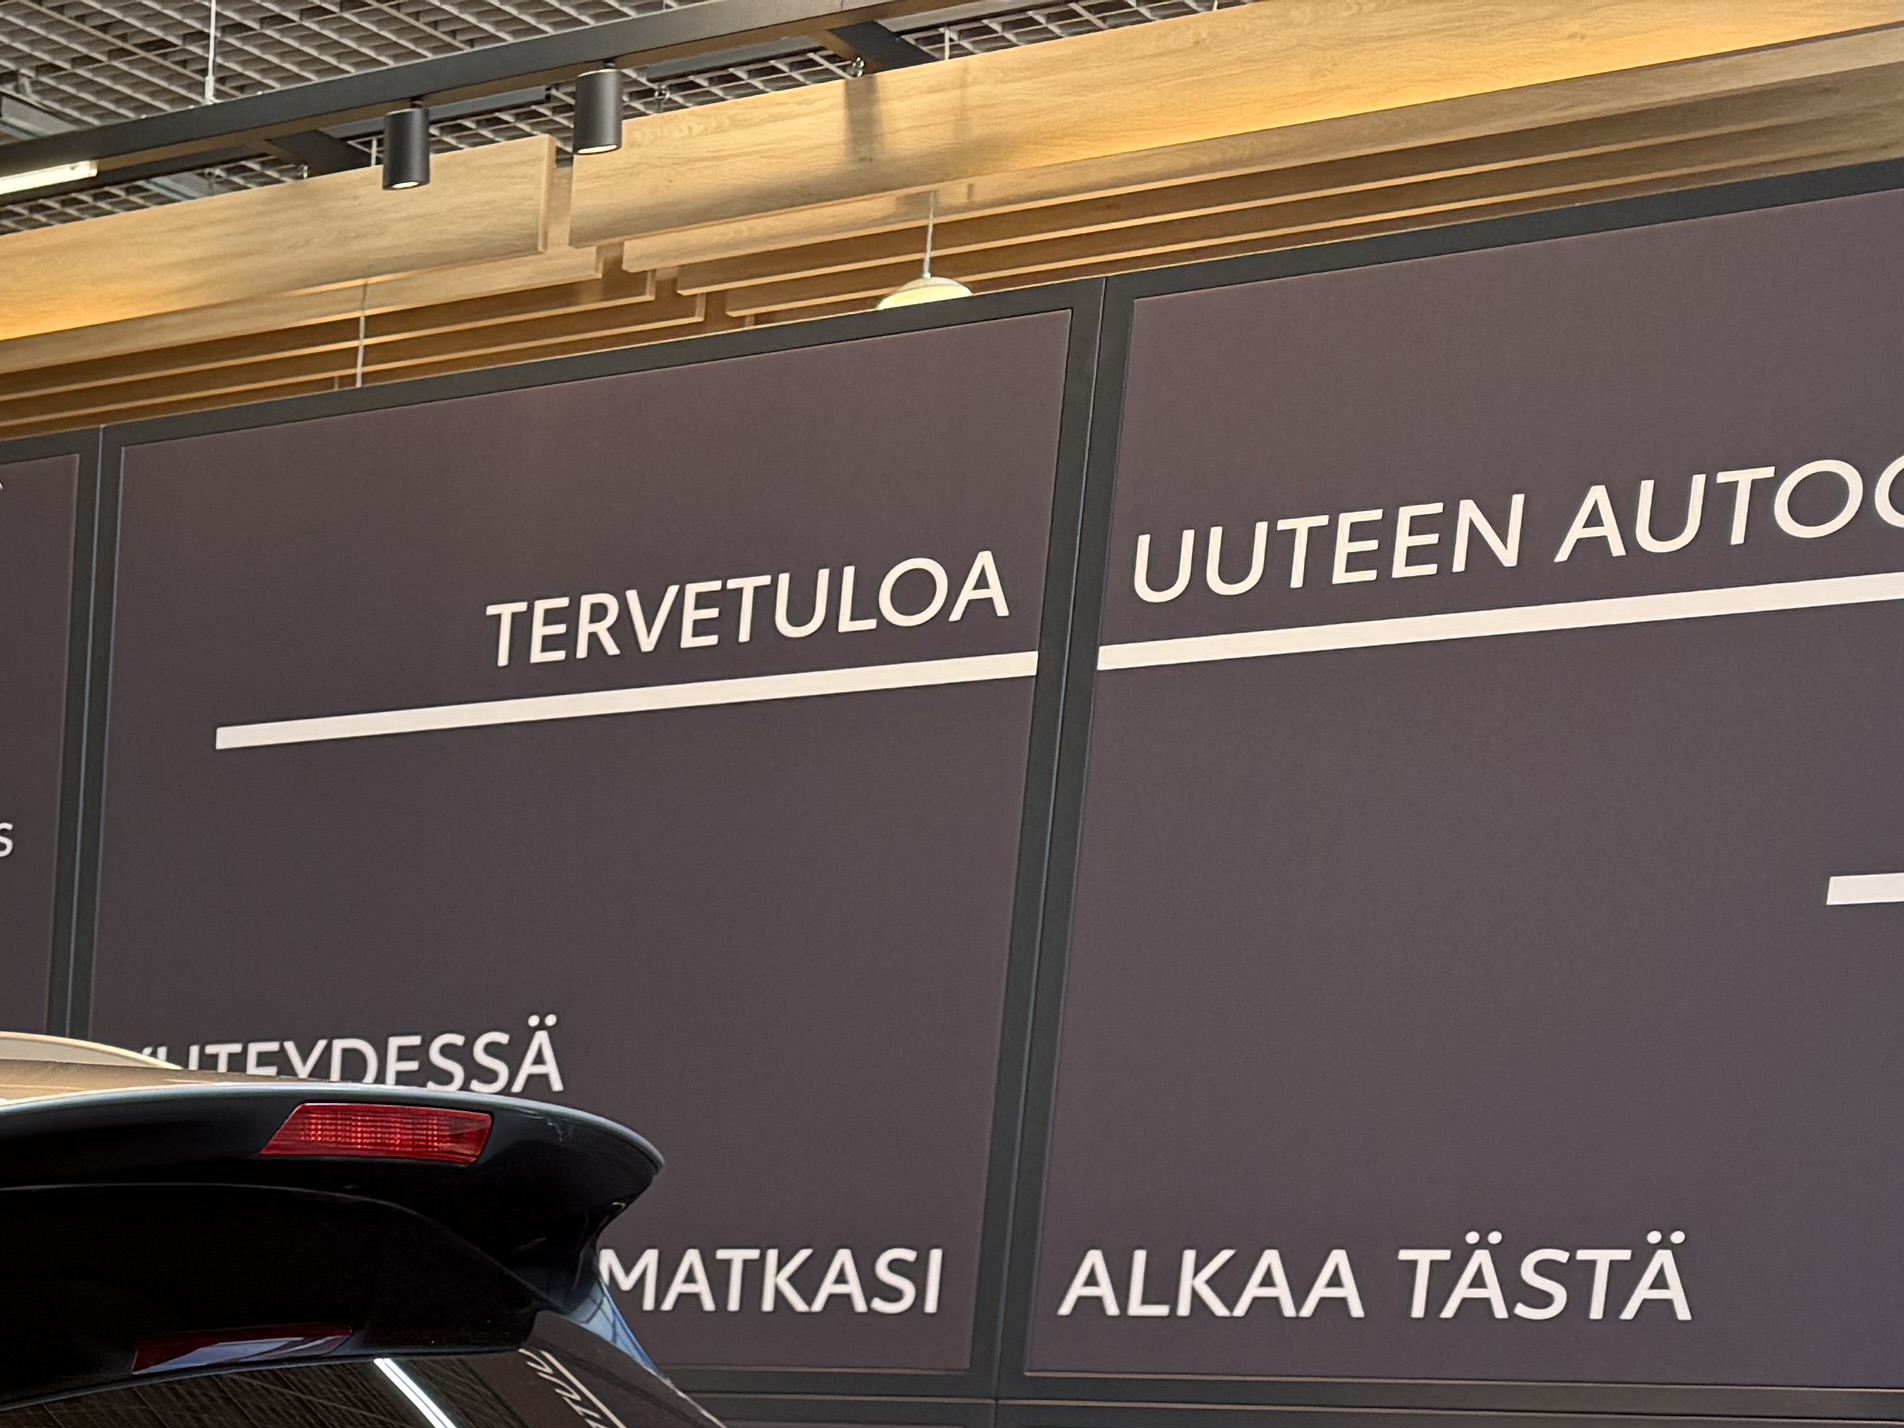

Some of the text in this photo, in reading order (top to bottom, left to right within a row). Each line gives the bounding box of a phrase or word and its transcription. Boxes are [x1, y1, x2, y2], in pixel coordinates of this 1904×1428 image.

[485, 550, 1009, 666] TERVETULOA
[1133, 493, 1525, 603] UUTEEN
[598, 1247, 944, 1314] MATKASI
[1057, 1230, 1692, 1321] ALKAA TÄSTÄ
